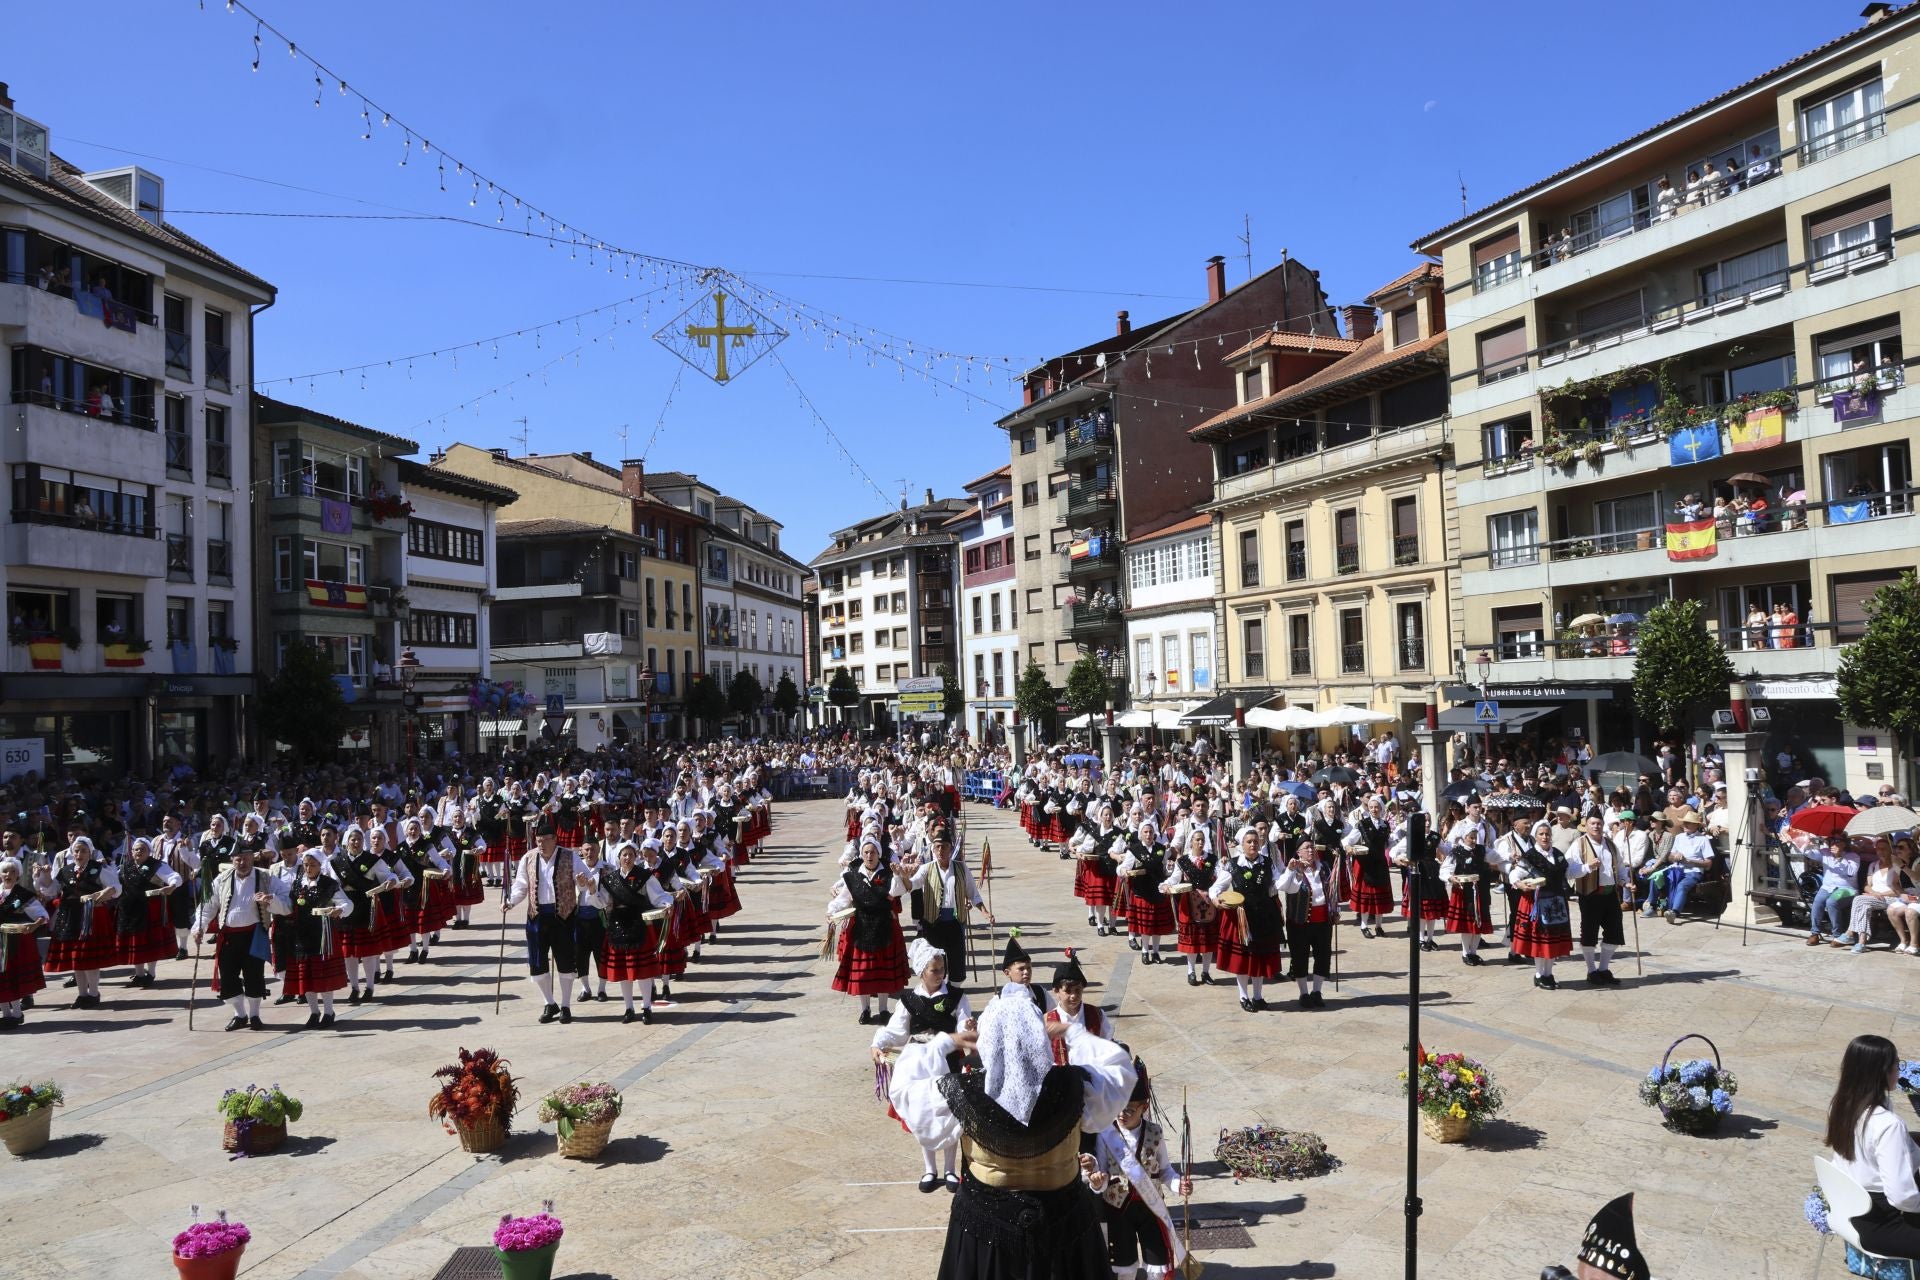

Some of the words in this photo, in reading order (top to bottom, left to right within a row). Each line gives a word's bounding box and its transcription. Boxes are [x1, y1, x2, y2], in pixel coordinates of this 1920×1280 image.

[1522, 688, 1532, 696] DE
[1533, 688, 1542, 697] LA
[1544, 688, 1565, 696] VILLA
[1813, 683, 1825, 693] de
[6, 750, 30, 763] 630
